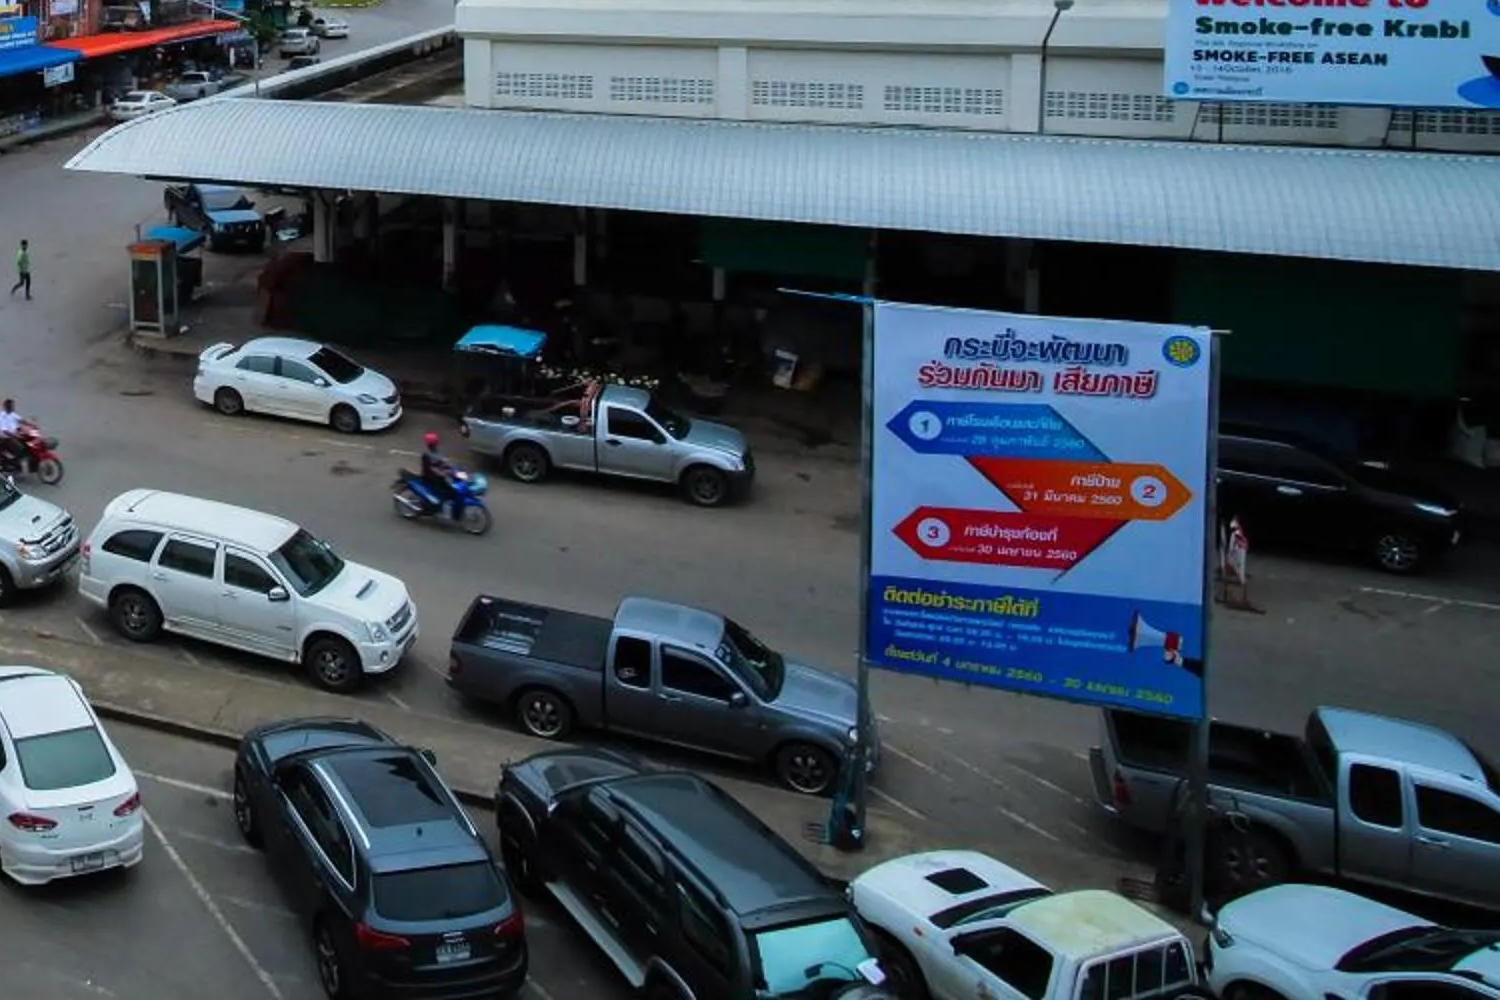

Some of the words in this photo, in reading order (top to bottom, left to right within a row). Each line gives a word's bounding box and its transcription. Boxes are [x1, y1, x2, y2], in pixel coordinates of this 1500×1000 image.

[1195, 16, 1374, 37] Smoke-free
[1193, 49, 1315, 64] SMOKE-FREE
[1321, 52, 1388, 66] ASEAN
[943, 328, 1129, 365] กระบี่จะพัฒนา
[917, 360, 1043, 392] ร่วมกันมา
[1053, 365, 1159, 397] เสียภาษี
[920, 419, 930, 433] 1
[1142, 484, 1156, 499] 2
[927, 525, 940, 539] 3
